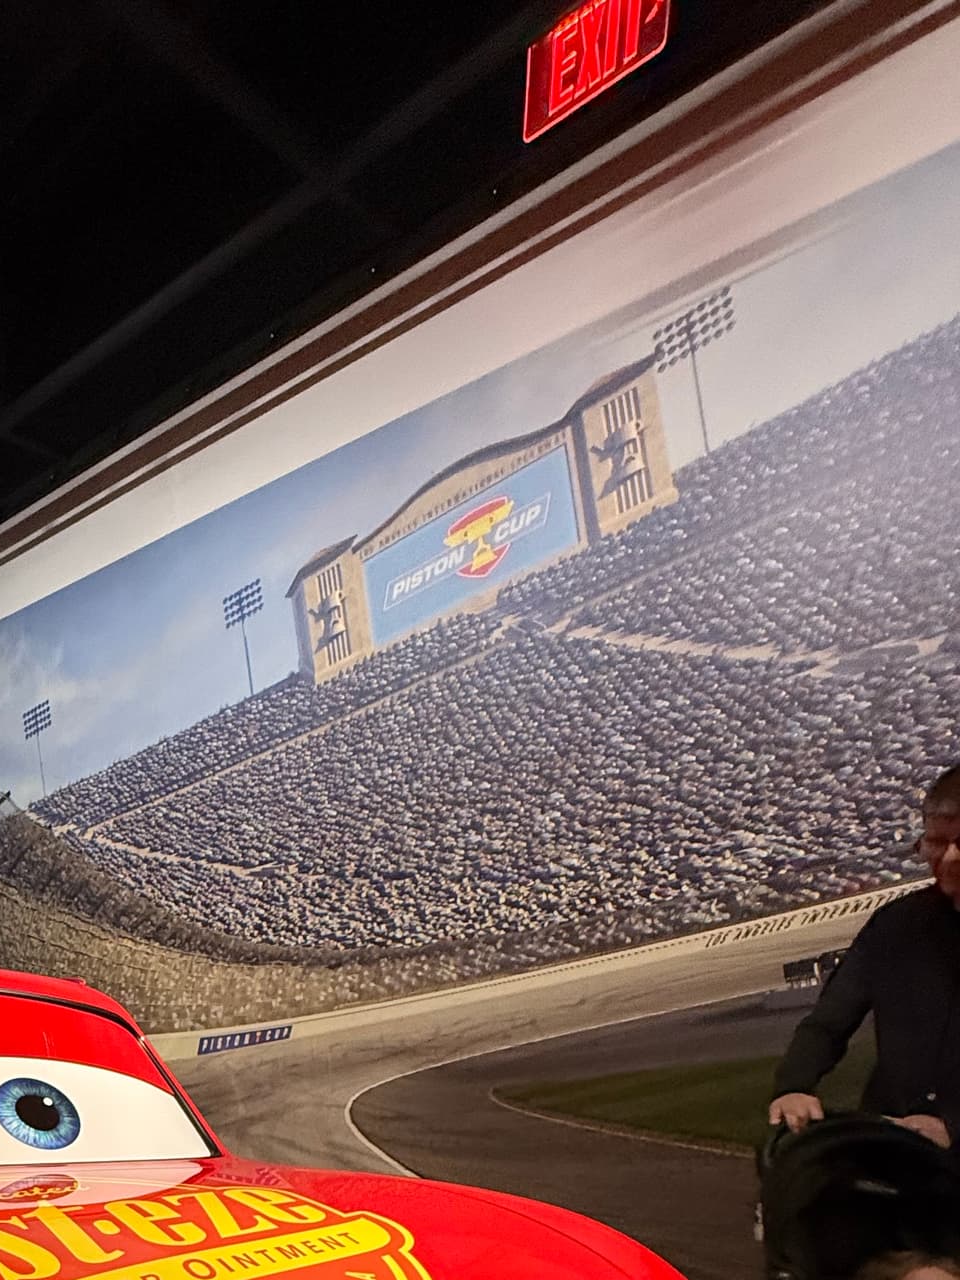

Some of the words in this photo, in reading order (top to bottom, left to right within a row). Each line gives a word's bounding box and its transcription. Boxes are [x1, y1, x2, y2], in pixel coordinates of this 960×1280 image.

[392, 545, 465, 601] PISTON
[494, 504, 541, 542] CUP
[705, 929, 733, 949] LOS
[733, 914, 798, 941] ANGELES
[201, 1033, 251, 1052] PISTON
[265, 1027, 289, 1042] CUP
[181, 1231, 361, 1280] OINTMENT
